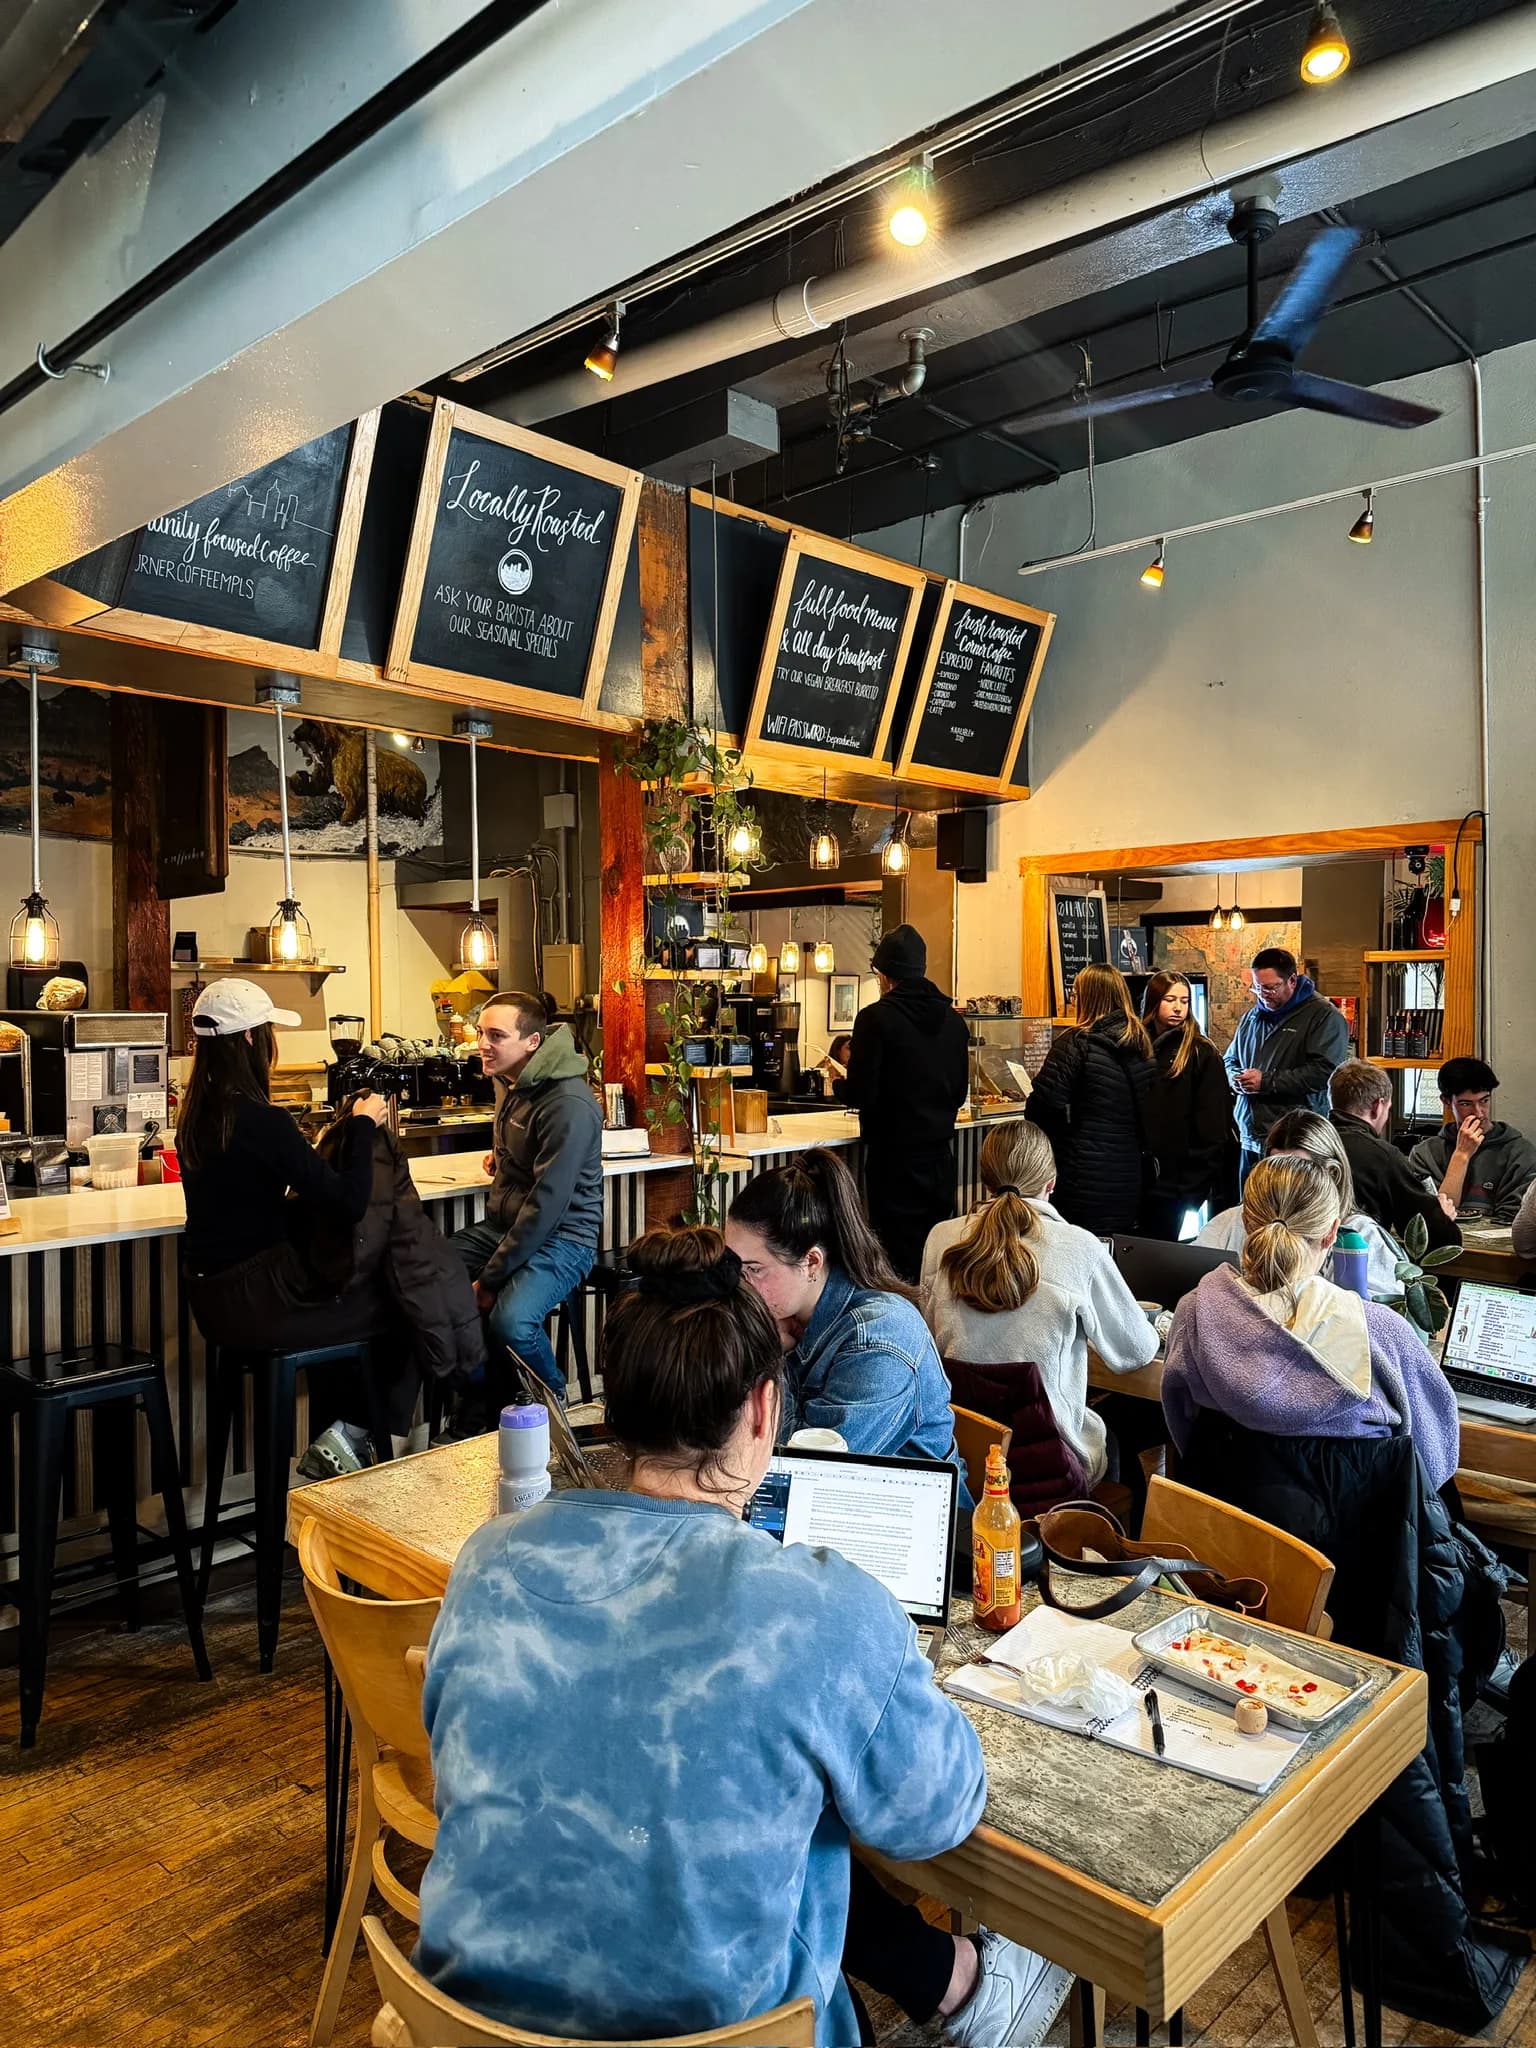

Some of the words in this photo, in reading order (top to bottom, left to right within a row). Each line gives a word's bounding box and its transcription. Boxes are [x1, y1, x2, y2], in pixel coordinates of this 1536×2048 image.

[446, 459, 536, 545] Locally
[530, 484, 605, 553] Roasted
[258, 540, 317, 572] Coffee
[434, 584, 461, 607] ASK
[465, 591, 492, 617] YOUR
[495, 600, 535, 631] BARISTA
[537, 613, 574, 641] ABOUT
[793, 578, 833, 629] full
[827, 590, 869, 632] food
[449, 614, 472, 637] OUR
[475, 621, 523, 650] SEASONAL
[523, 631, 558, 659] SPECIALS
[953, 608, 987, 642] fresh
[983, 619, 1028, 650] roasted
[779, 628, 790, 653] &
[812, 630, 836, 673] day
[836, 633, 888, 673] breakfast
[939, 651, 973, 671] ESPRESSO
[776, 666, 790, 681] TRY
[790, 669, 803, 684] OUR
[804, 672, 824, 689] VEGAN
[823, 676, 855, 695] BREAKFAST
[854, 681, 879, 700] BURRITO
[980, 660, 1016, 684] FAVORITES
[767, 714, 788, 735] WIFI
